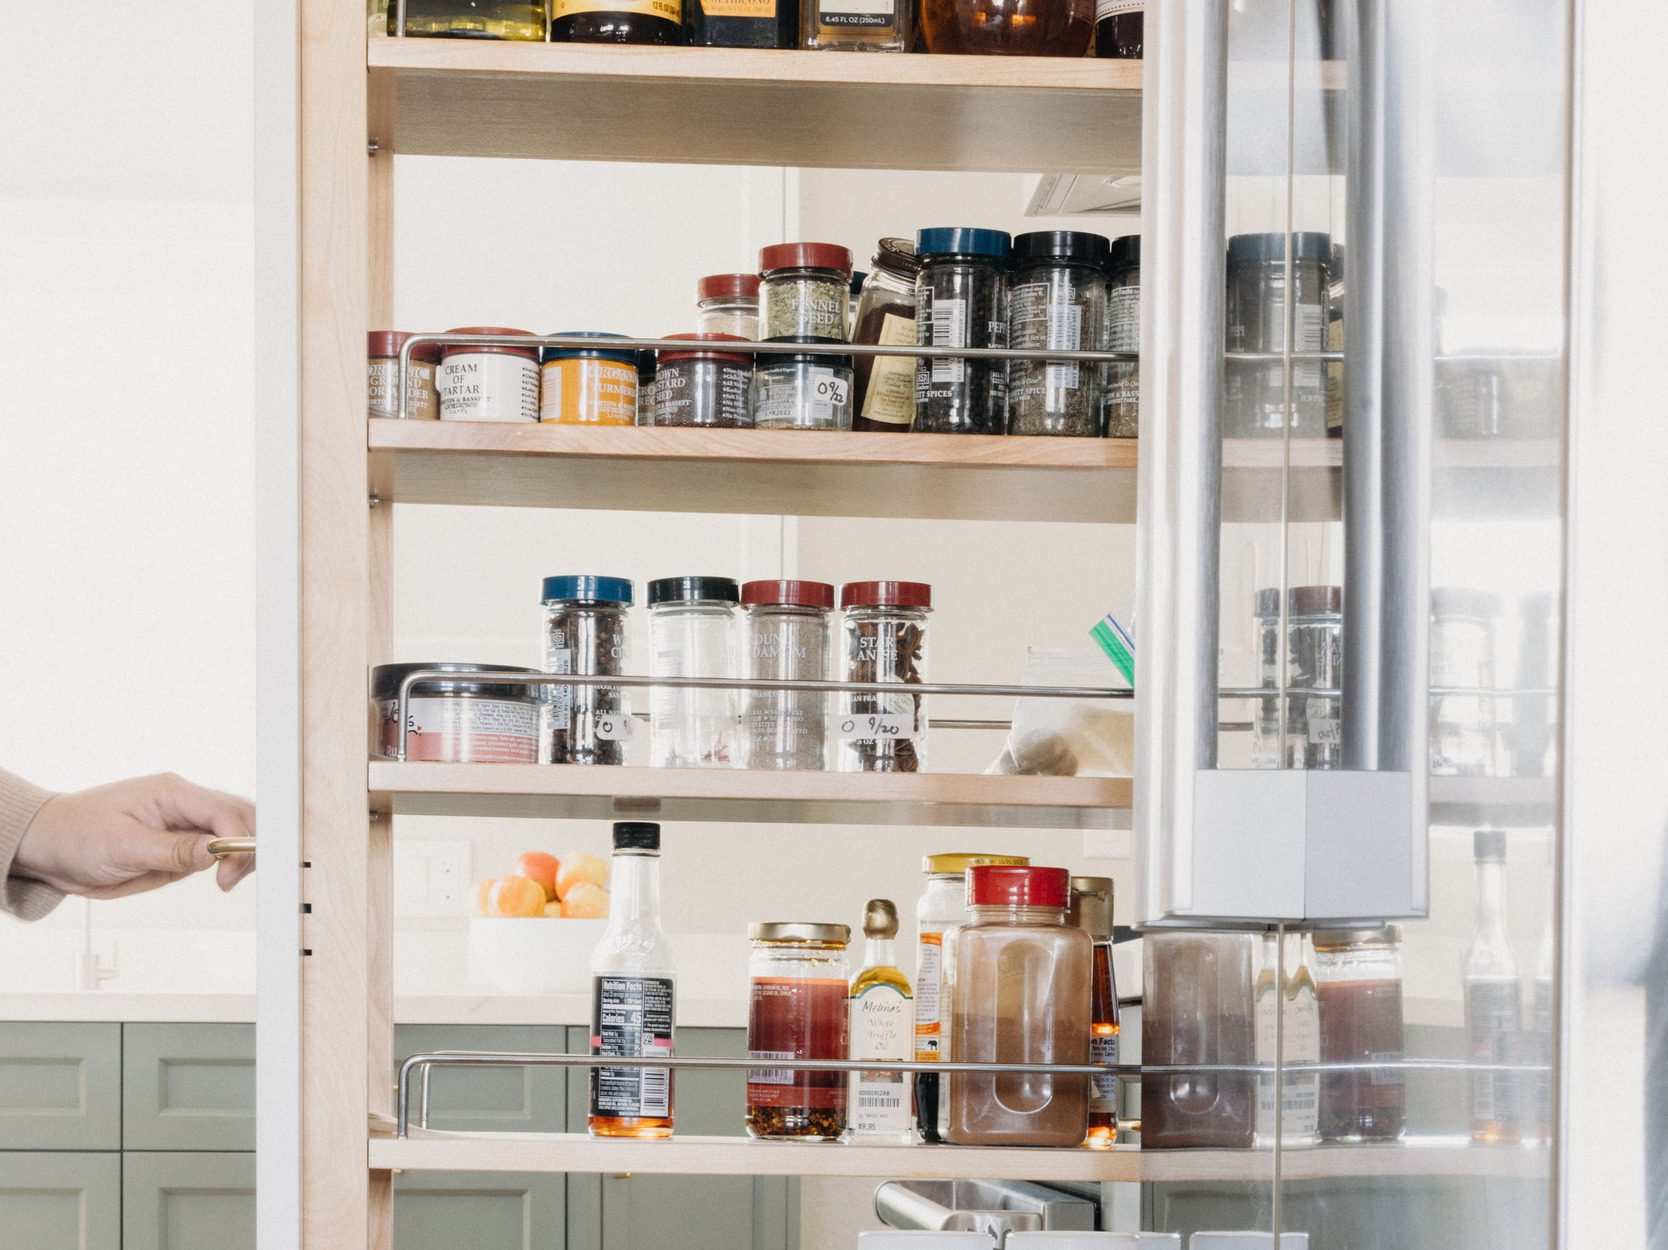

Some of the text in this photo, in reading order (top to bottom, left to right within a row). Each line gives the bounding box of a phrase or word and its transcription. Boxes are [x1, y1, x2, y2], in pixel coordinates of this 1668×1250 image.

[445, 364, 478, 375] CREAM
[452, 375, 465, 384] OF
[444, 384, 480, 396] TARTAR
[860, 637, 893, 648] STAR
[857, 650, 898, 660] ANSE
[868, 716, 900, 735] 9/20
[626, 980, 642, 990] Facts
